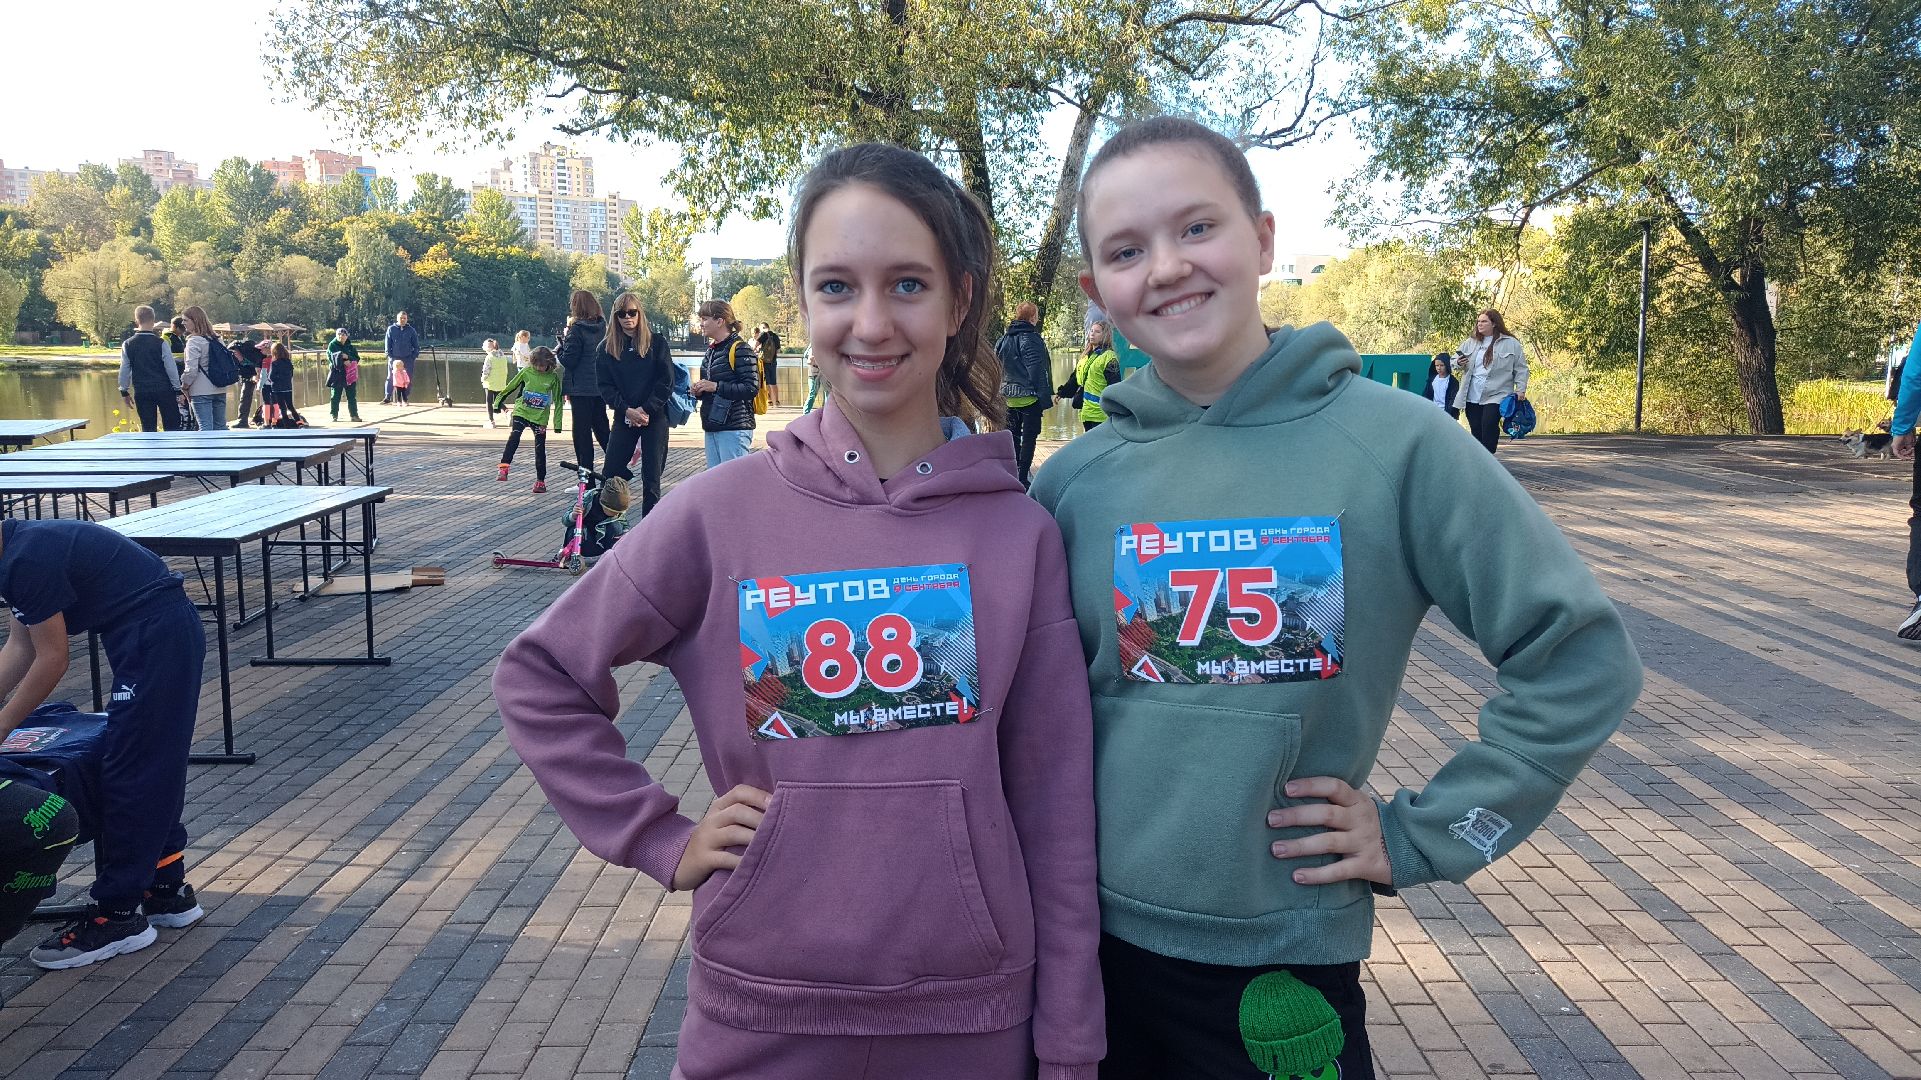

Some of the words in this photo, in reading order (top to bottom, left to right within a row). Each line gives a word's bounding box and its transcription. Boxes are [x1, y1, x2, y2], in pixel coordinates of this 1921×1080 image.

[1120, 528, 1257, 556] РЕУТОВ
[1260, 528, 1287, 536] ДЕНЬ
[1290, 526, 1330, 535] ГОРОДА
[1272, 535, 1331, 545] СЕНТЯБРЯ
[921, 573, 960, 583] ГОРОДА
[745, 577, 891, 610] РЕУТОВ
[1169, 566, 1282, 647] 75
[802, 613, 924, 699] 88
[1197, 660, 1226, 675] МЫ
[1234, 653, 1332, 674] ВМЕСТЕ!
[834, 709, 866, 727] МЫ
[873, 697, 968, 722] ВМЕСТЕ!
